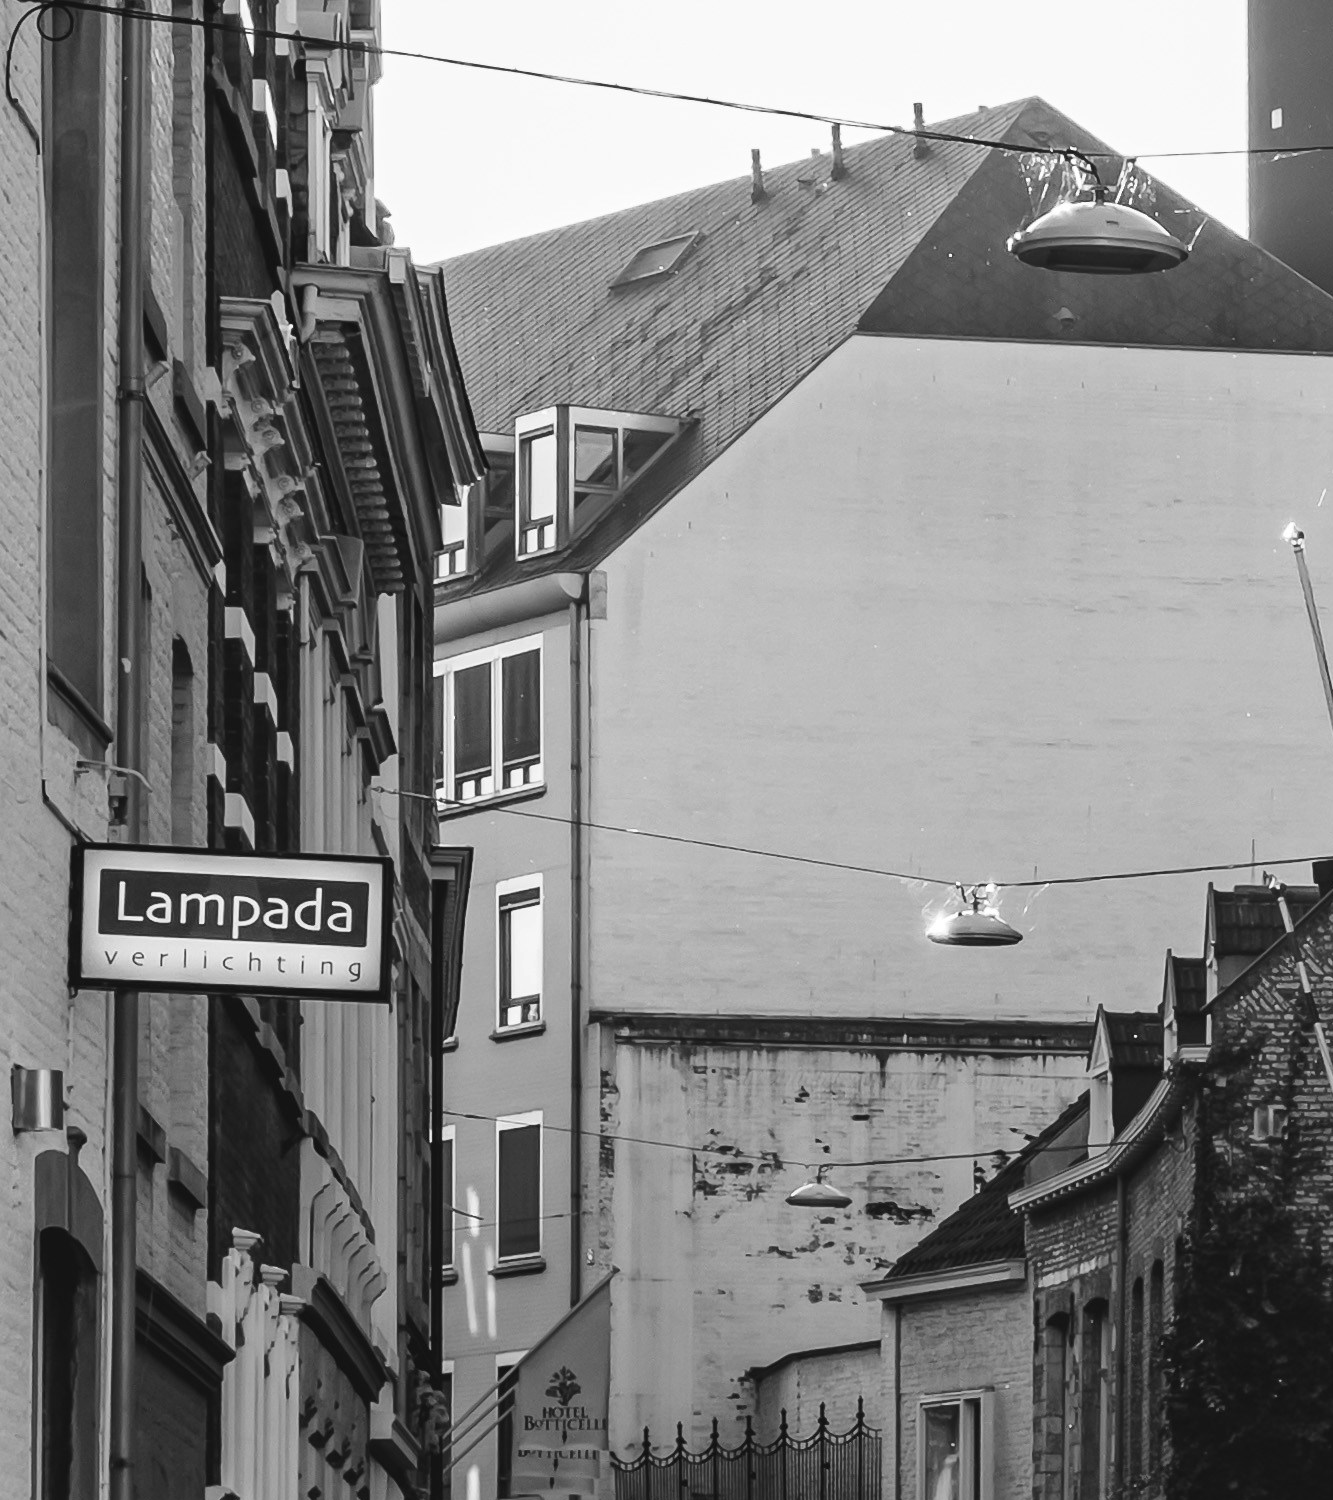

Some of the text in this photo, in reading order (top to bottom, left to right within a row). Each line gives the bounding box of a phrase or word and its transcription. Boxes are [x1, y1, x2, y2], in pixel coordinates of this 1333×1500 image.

[118, 880, 352, 939] Lampada
[105, 948, 361, 982] verlichting
[543, 1407, 588, 1418] HOTEL
